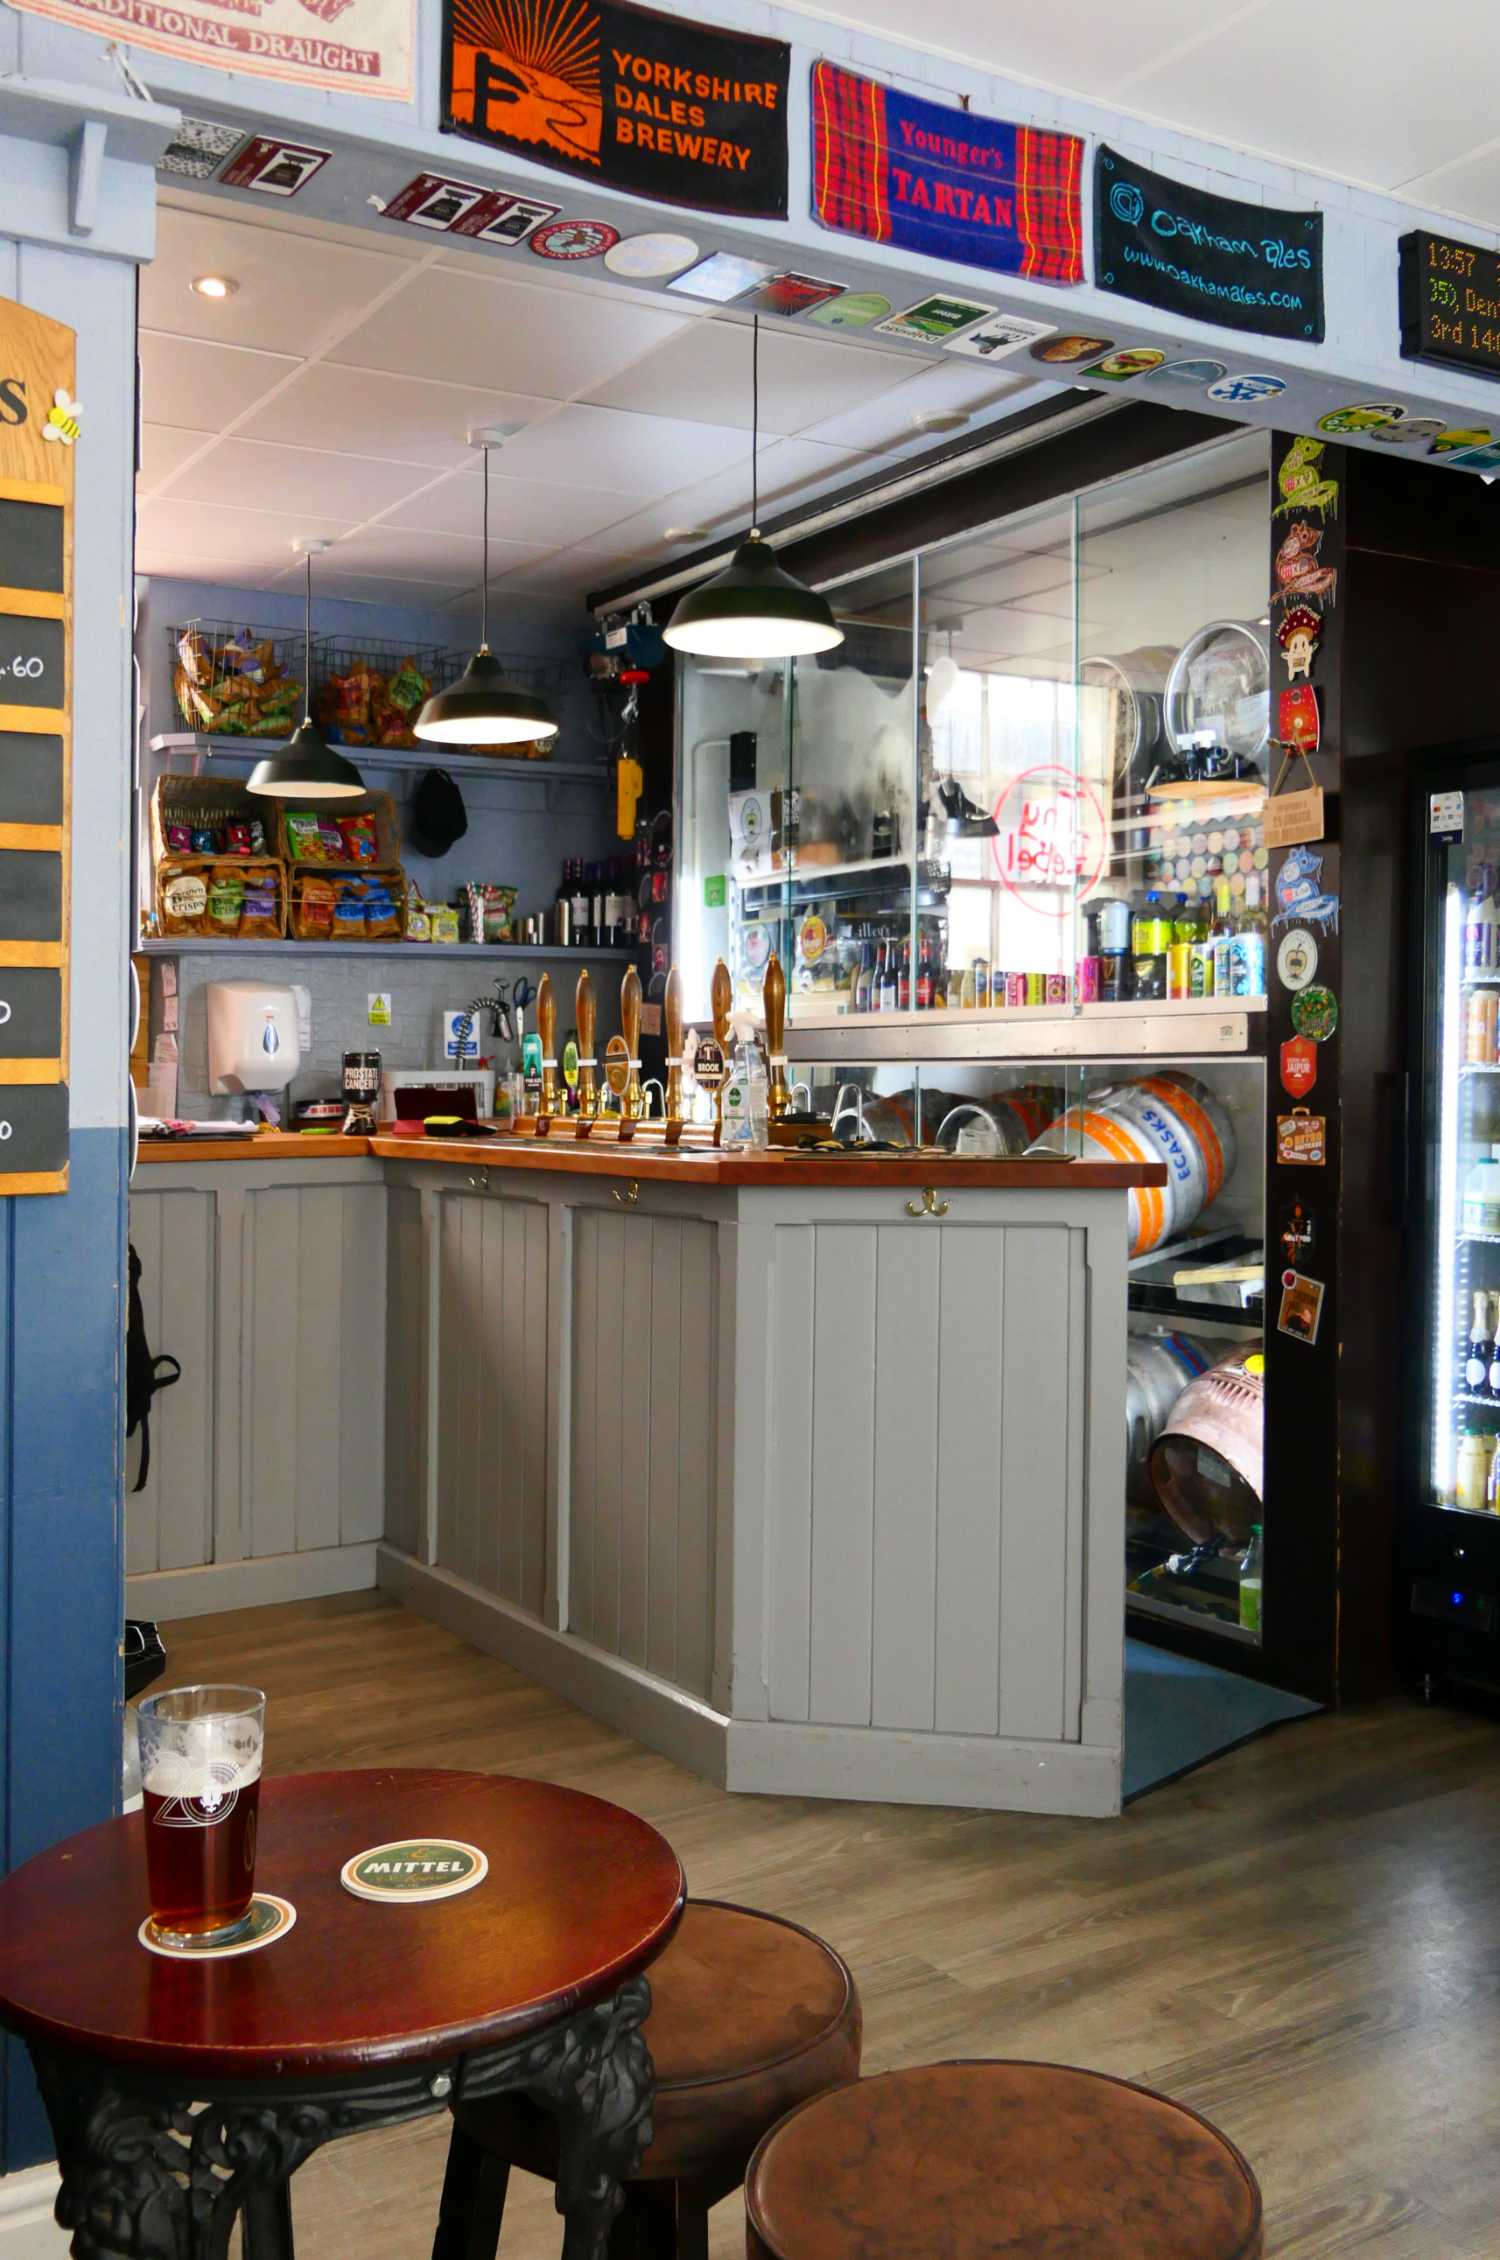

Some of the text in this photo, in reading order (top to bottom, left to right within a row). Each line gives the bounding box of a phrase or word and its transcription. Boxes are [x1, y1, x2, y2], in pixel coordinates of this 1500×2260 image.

[249, 33, 373, 72] DRAUGHT
[611, 49, 779, 110] YORKSHIRE
[614, 84, 705, 128] DALES
[615, 117, 752, 171] BREWERY
[900, 120, 1004, 169] Younger's
[892, 168, 1012, 229] TARTAN
[1151, 208, 1258, 258] Oakham
[1427, 242, 1477, 277] 13:57
[1431, 314, 1463, 344] 3rd
[0, 655, 44, 678] .60
[1141, 1110, 1191, 1182] ECASKS
[363, 1860, 465, 1874] MITTEL
